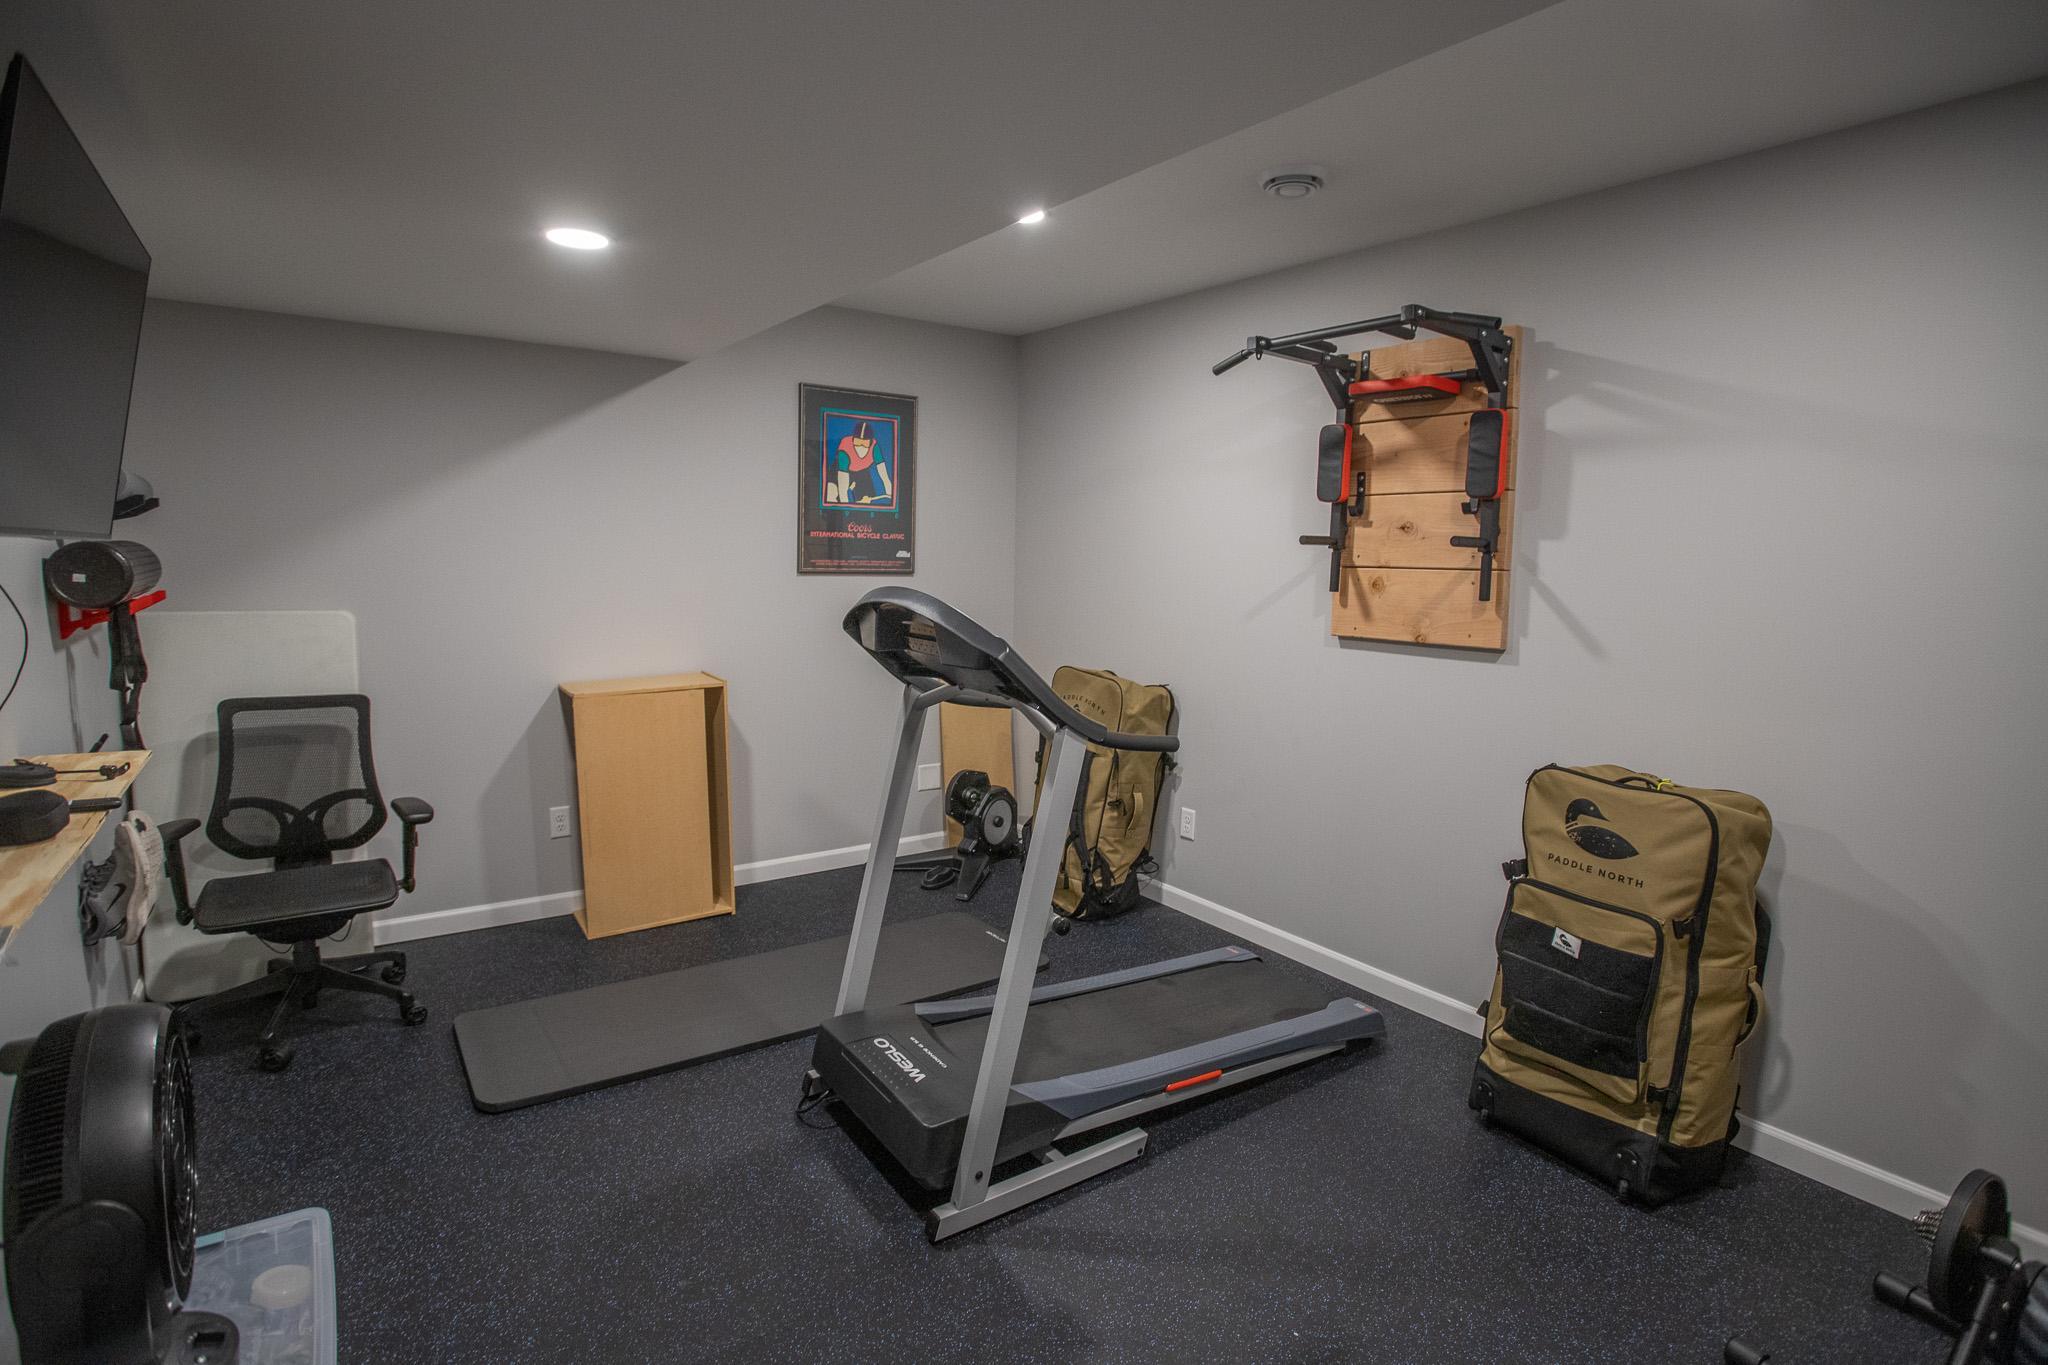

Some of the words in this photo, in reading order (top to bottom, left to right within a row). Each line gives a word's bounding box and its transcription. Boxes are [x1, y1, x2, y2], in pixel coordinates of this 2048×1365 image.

[810, 531, 855, 539] INTERNATIONAL
[856, 532, 880, 540] BICYCLE
[1547, 852, 1593, 874] PADDLE
[1598, 868, 1644, 889] NORTH
[873, 1037, 926, 1083] WESLO
